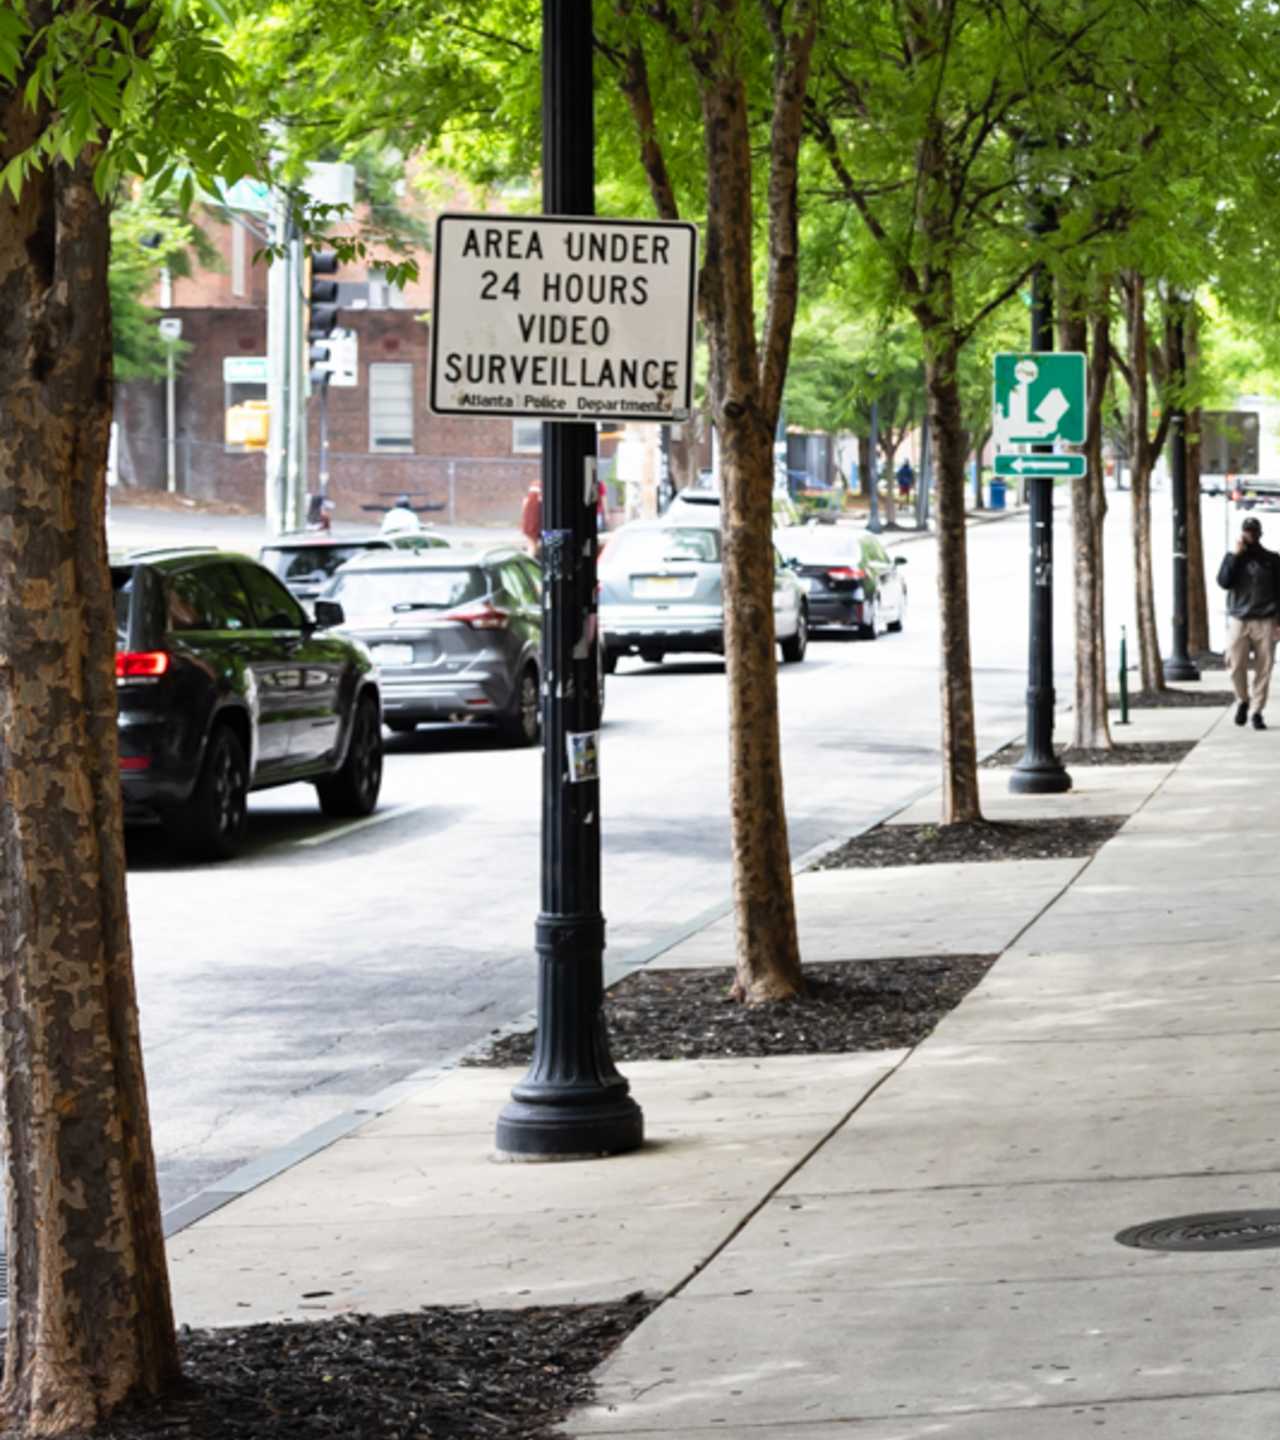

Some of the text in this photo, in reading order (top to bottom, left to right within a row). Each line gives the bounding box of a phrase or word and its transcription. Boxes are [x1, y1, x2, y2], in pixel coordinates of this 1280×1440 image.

[462, 228, 670, 264] AREA UNDER
[480, 270, 648, 306] 24 HOURS
[518, 314, 610, 346] VIDEO
[445, 353, 678, 391] SURVEILLANCE
[462, 394, 665, 413] Atlanta Police Department
